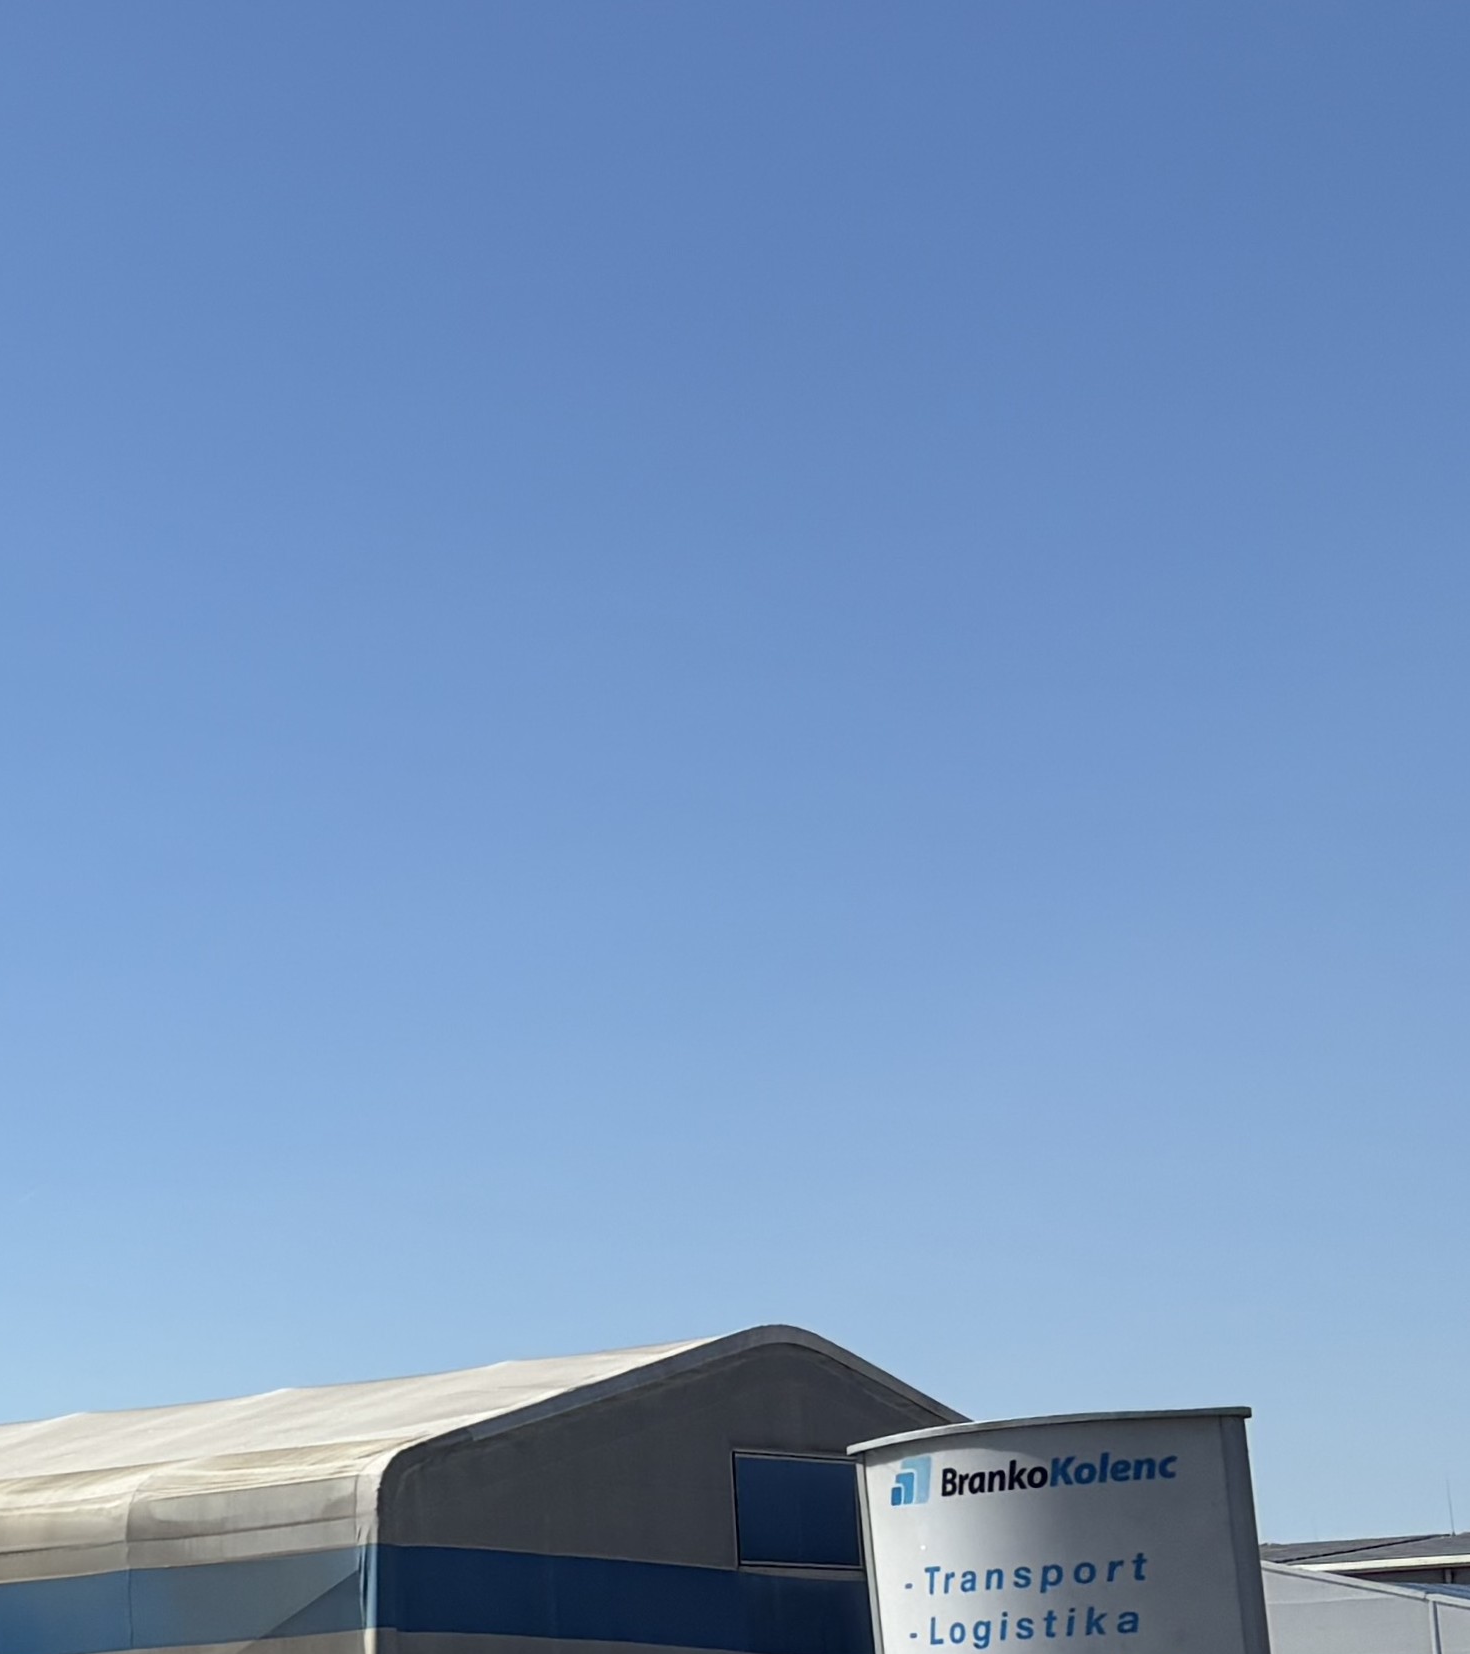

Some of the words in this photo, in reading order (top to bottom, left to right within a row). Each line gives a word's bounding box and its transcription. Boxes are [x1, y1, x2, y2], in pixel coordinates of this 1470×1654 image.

[941, 1452, 1177, 1497] BrankoKolenc
[925, 1552, 1148, 1596] Transport
[930, 1607, 1140, 1649] Logistika
